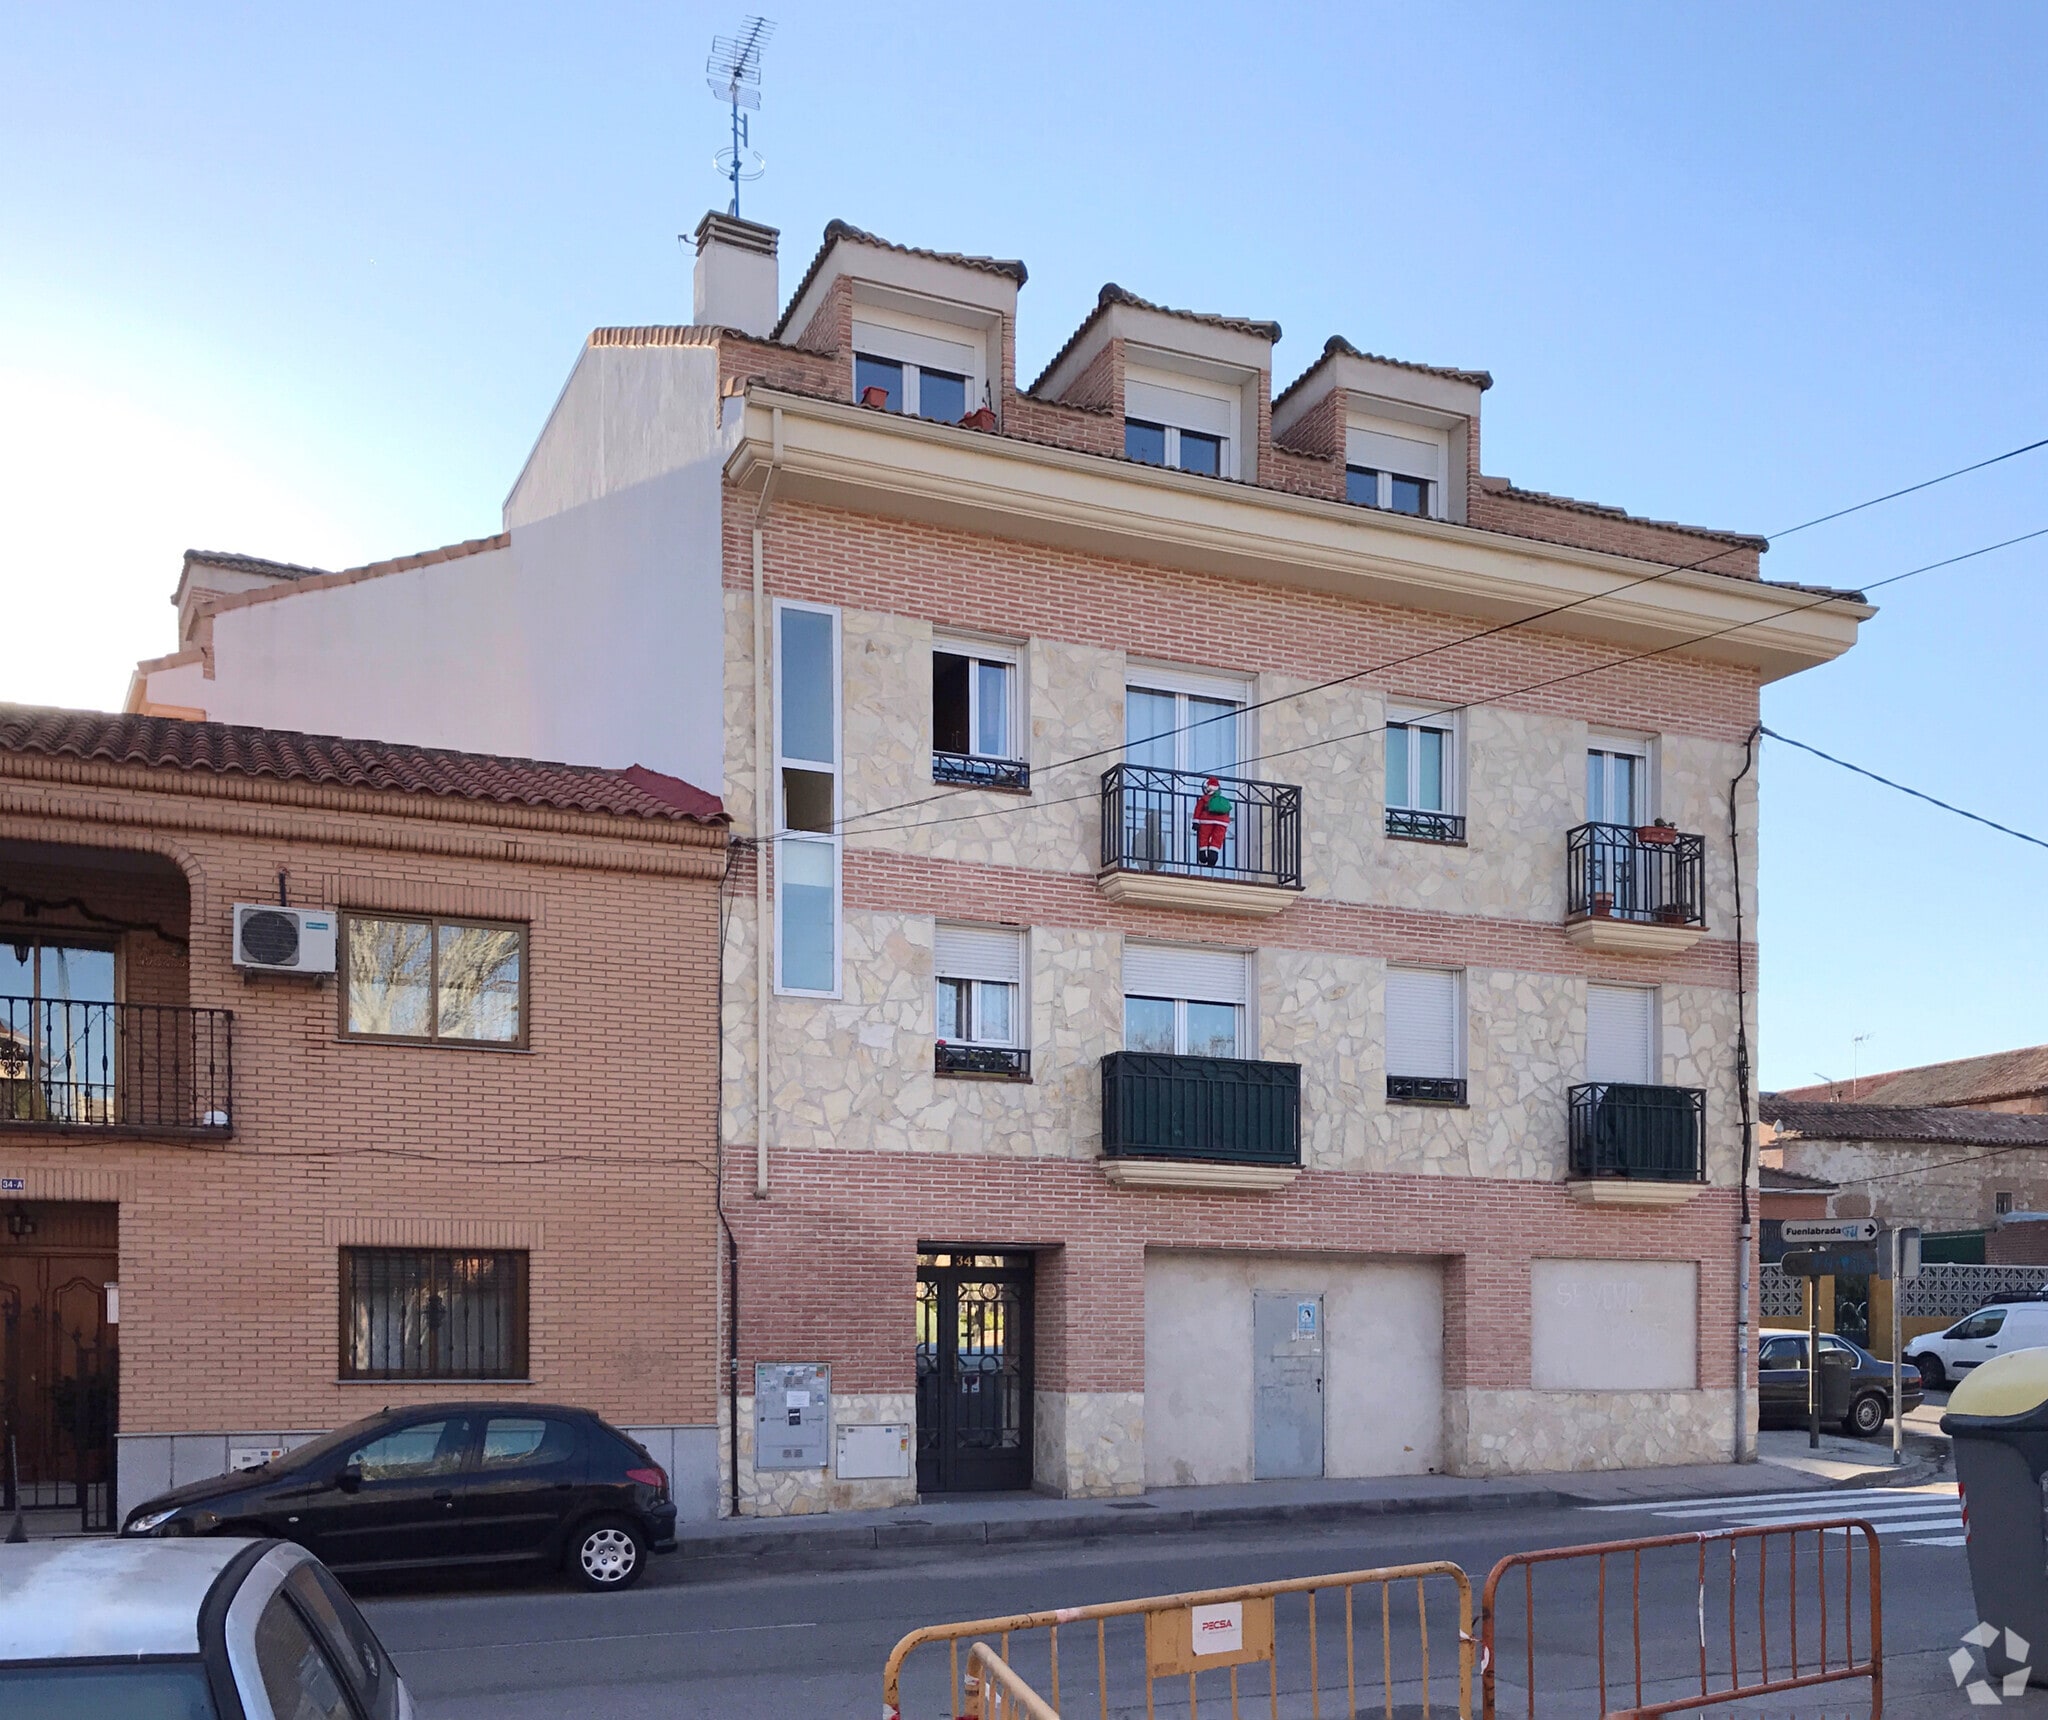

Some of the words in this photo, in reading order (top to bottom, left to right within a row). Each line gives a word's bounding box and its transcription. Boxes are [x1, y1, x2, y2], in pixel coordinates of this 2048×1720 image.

[2, 1180, 23, 1189] 34-A
[1786, 1226, 1841, 1236] Fuenlabrada
[955, 1255, 972, 1267] 34
[1202, 1619, 1232, 1631] PECSA
